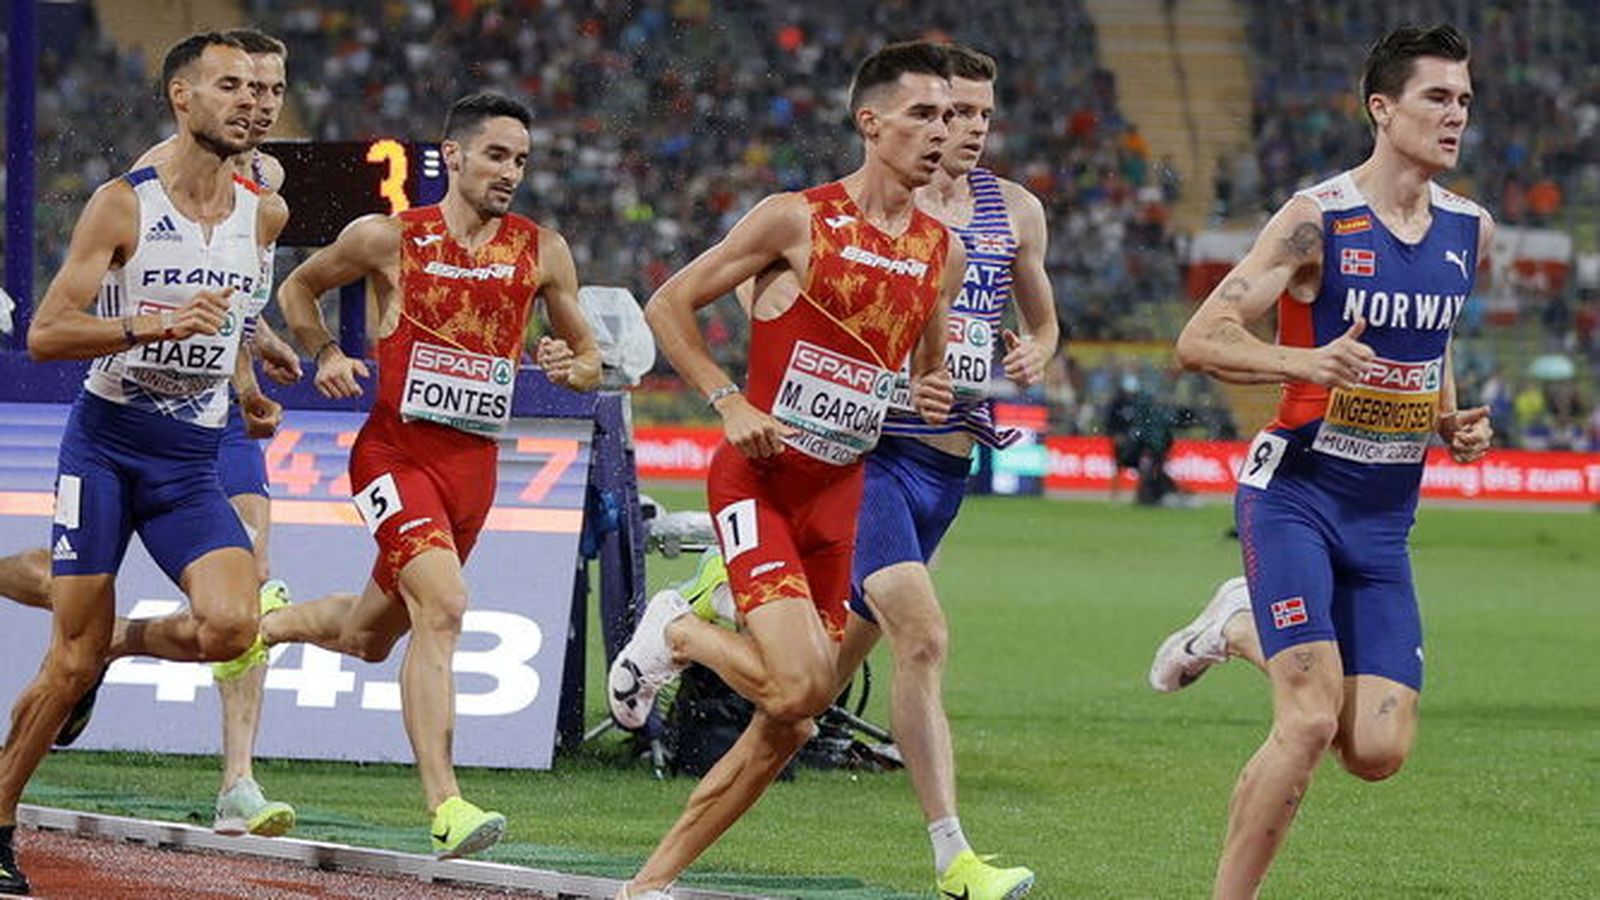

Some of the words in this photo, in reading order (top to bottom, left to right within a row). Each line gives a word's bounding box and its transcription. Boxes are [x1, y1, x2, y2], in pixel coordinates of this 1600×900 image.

[963, 264, 1001, 286] AT
[953, 287, 996, 311] AIN
[1343, 288, 1465, 330] NORWAY
[141, 340, 226, 371] HABZ
[414, 349, 491, 379] SPAR
[795, 349, 874, 392] SPAR
[1359, 364, 1424, 387] PAR
[406, 379, 507, 418] FONTES
[811, 392, 880, 437] GARCIA
[1249, 440, 1273, 476] 9
[1320, 434, 1383, 459] MUNICH
[371, 486, 389, 519] 5
[728, 511, 740, 546] 1
